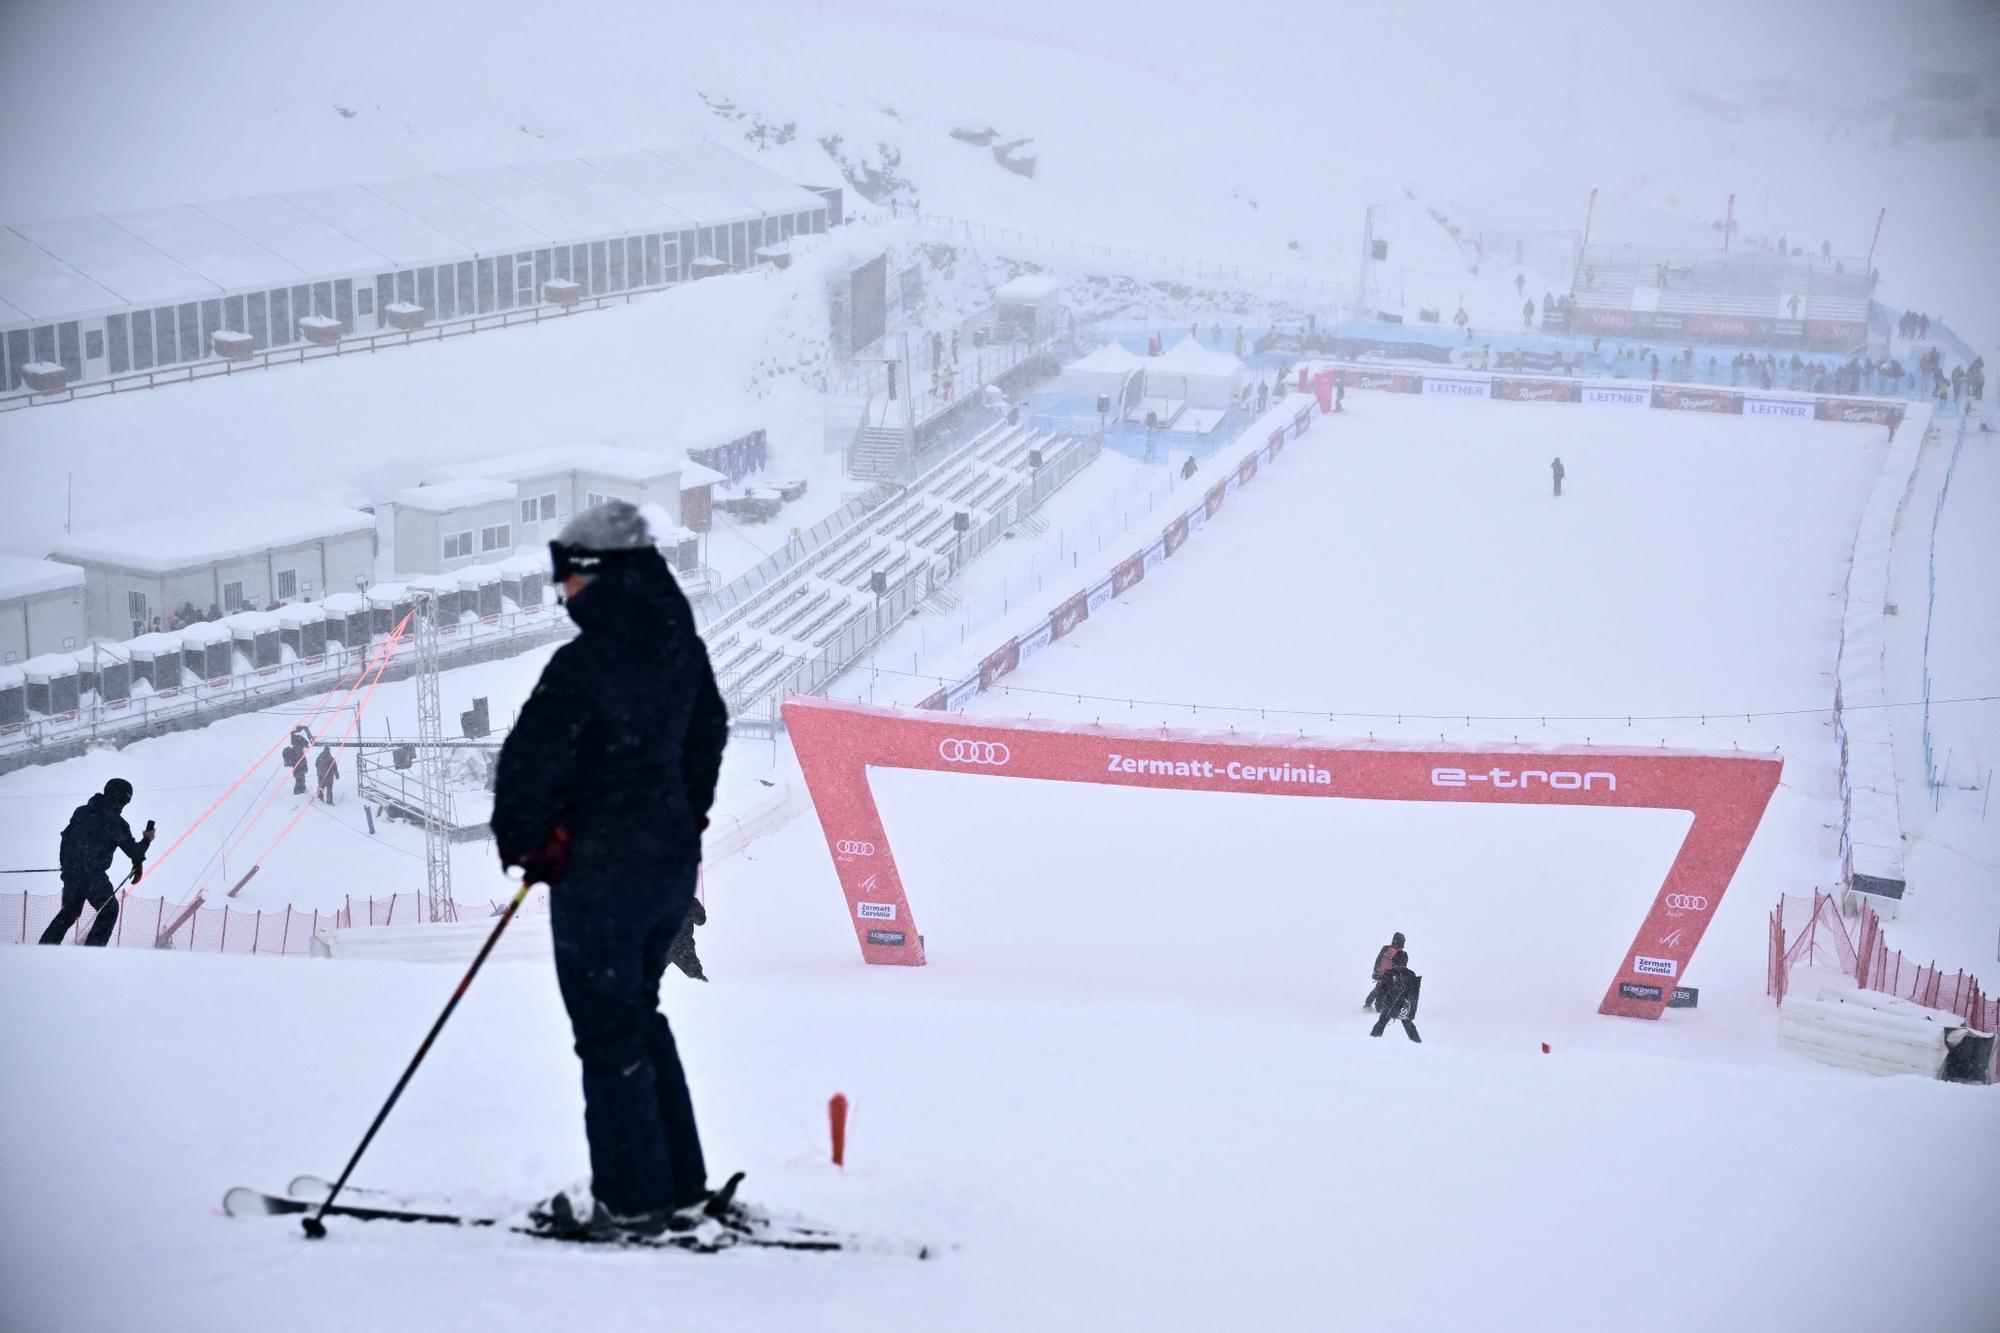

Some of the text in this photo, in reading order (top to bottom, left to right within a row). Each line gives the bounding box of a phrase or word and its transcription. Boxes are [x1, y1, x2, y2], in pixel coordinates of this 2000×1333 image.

[1429, 383, 1484, 396] LEITNER
[1589, 392, 1644, 404] LEITNER
[1751, 404, 1807, 417] LEITNER
[1022, 632, 1050, 661] LEITNER
[1107, 753, 1332, 785] Zermatt-Cervinia
[1431, 767, 1617, 791] e-tron
[861, 904, 891, 912] Zermatt
[861, 910, 891, 918] Cervinia
[870, 931, 904, 940] LONGINES
[1639, 958, 1672, 968] Zermatt
[1638, 965, 1671, 975] Cervinia
[1623, 985, 1659, 995] LONGINES
